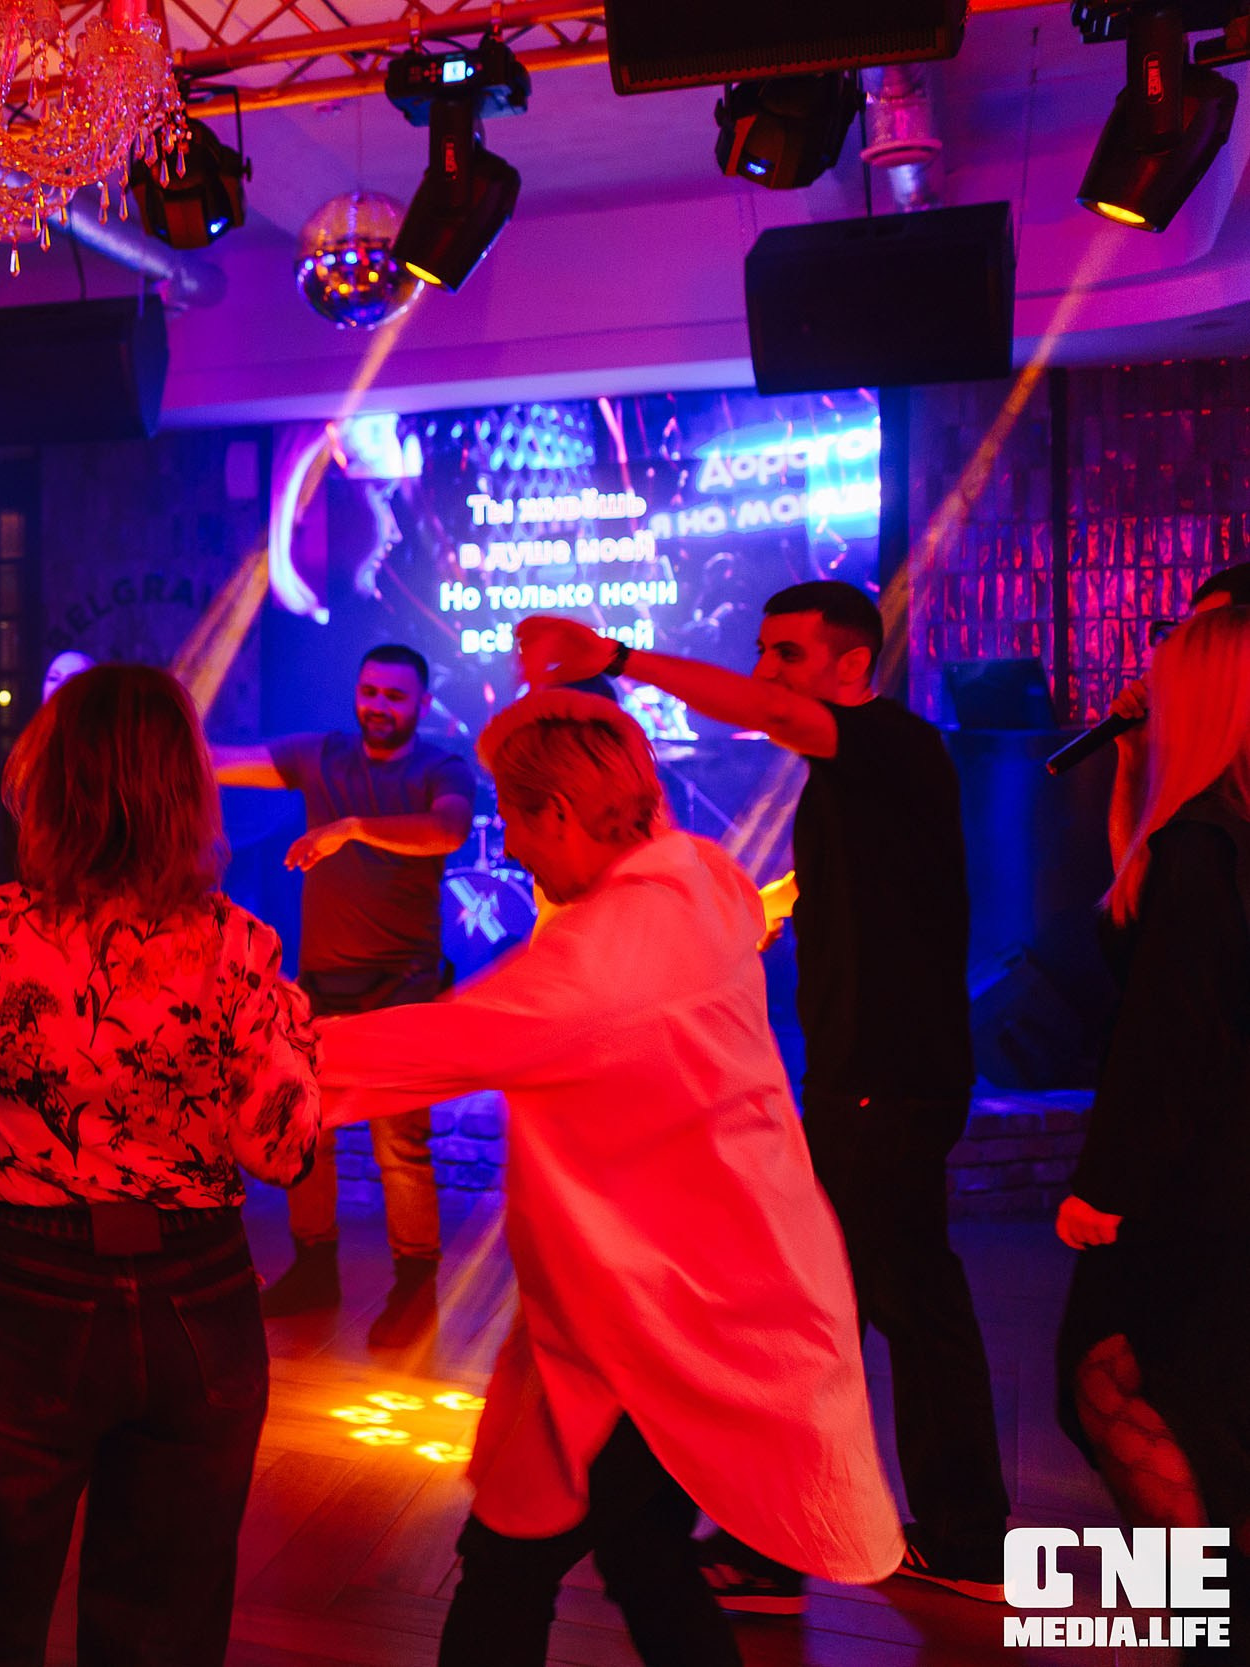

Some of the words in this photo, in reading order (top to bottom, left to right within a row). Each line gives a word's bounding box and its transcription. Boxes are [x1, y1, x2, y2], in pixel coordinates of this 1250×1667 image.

[467, 494, 513, 525] Ты
[517, 488, 647, 523] живёшь
[460, 543, 481, 569] в
[484, 539, 571, 572] душе
[576, 529, 655, 563] моей
[440, 581, 481, 611] Но
[485, 583, 594, 610] только
[599, 580, 677, 606] ночи
[461, 623, 513, 653] всё
